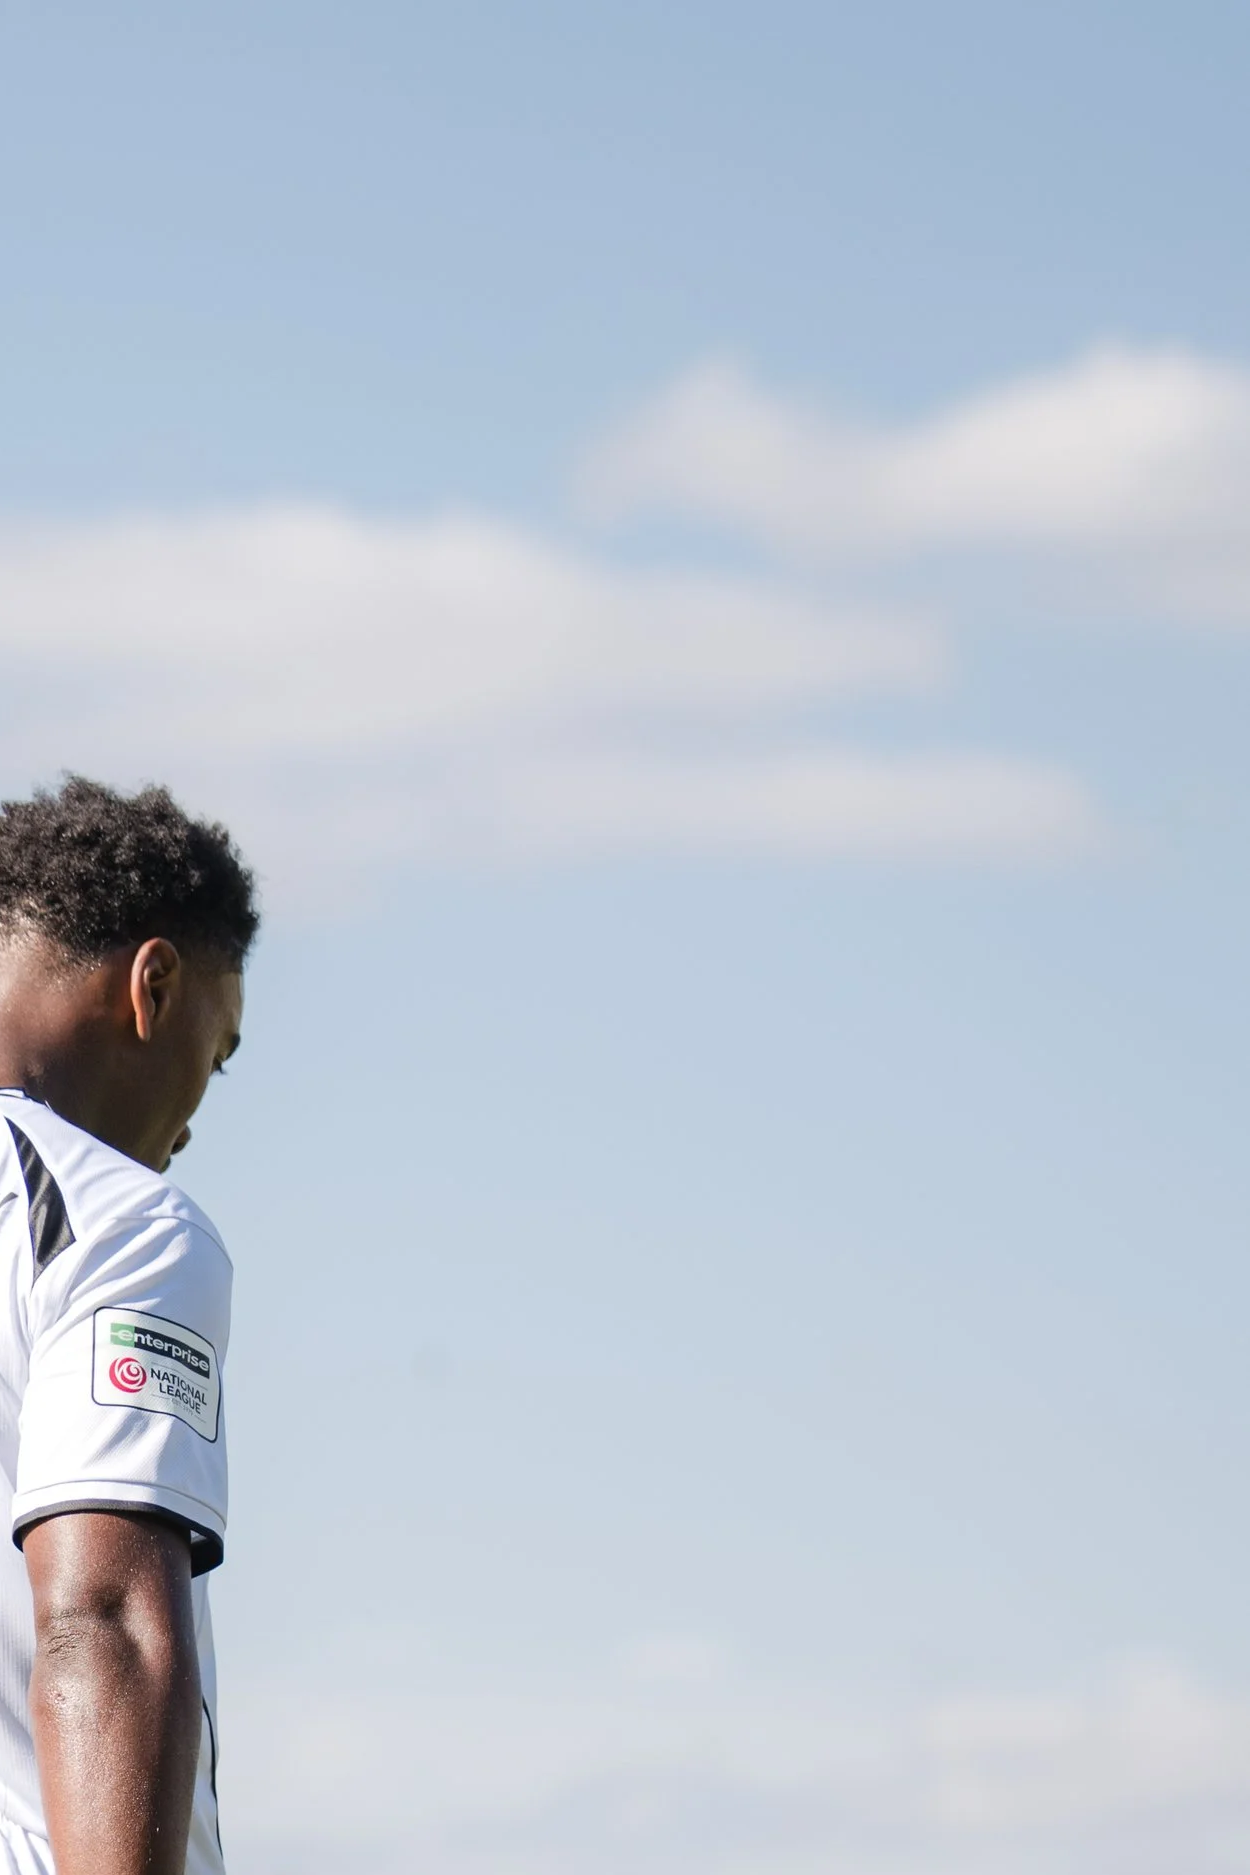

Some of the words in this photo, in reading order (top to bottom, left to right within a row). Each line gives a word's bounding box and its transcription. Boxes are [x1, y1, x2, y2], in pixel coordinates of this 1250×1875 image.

[113, 1328, 210, 1371] enterprise
[150, 1367, 208, 1406] NATIONAL
[158, 1382, 201, 1415] LEAGUE
